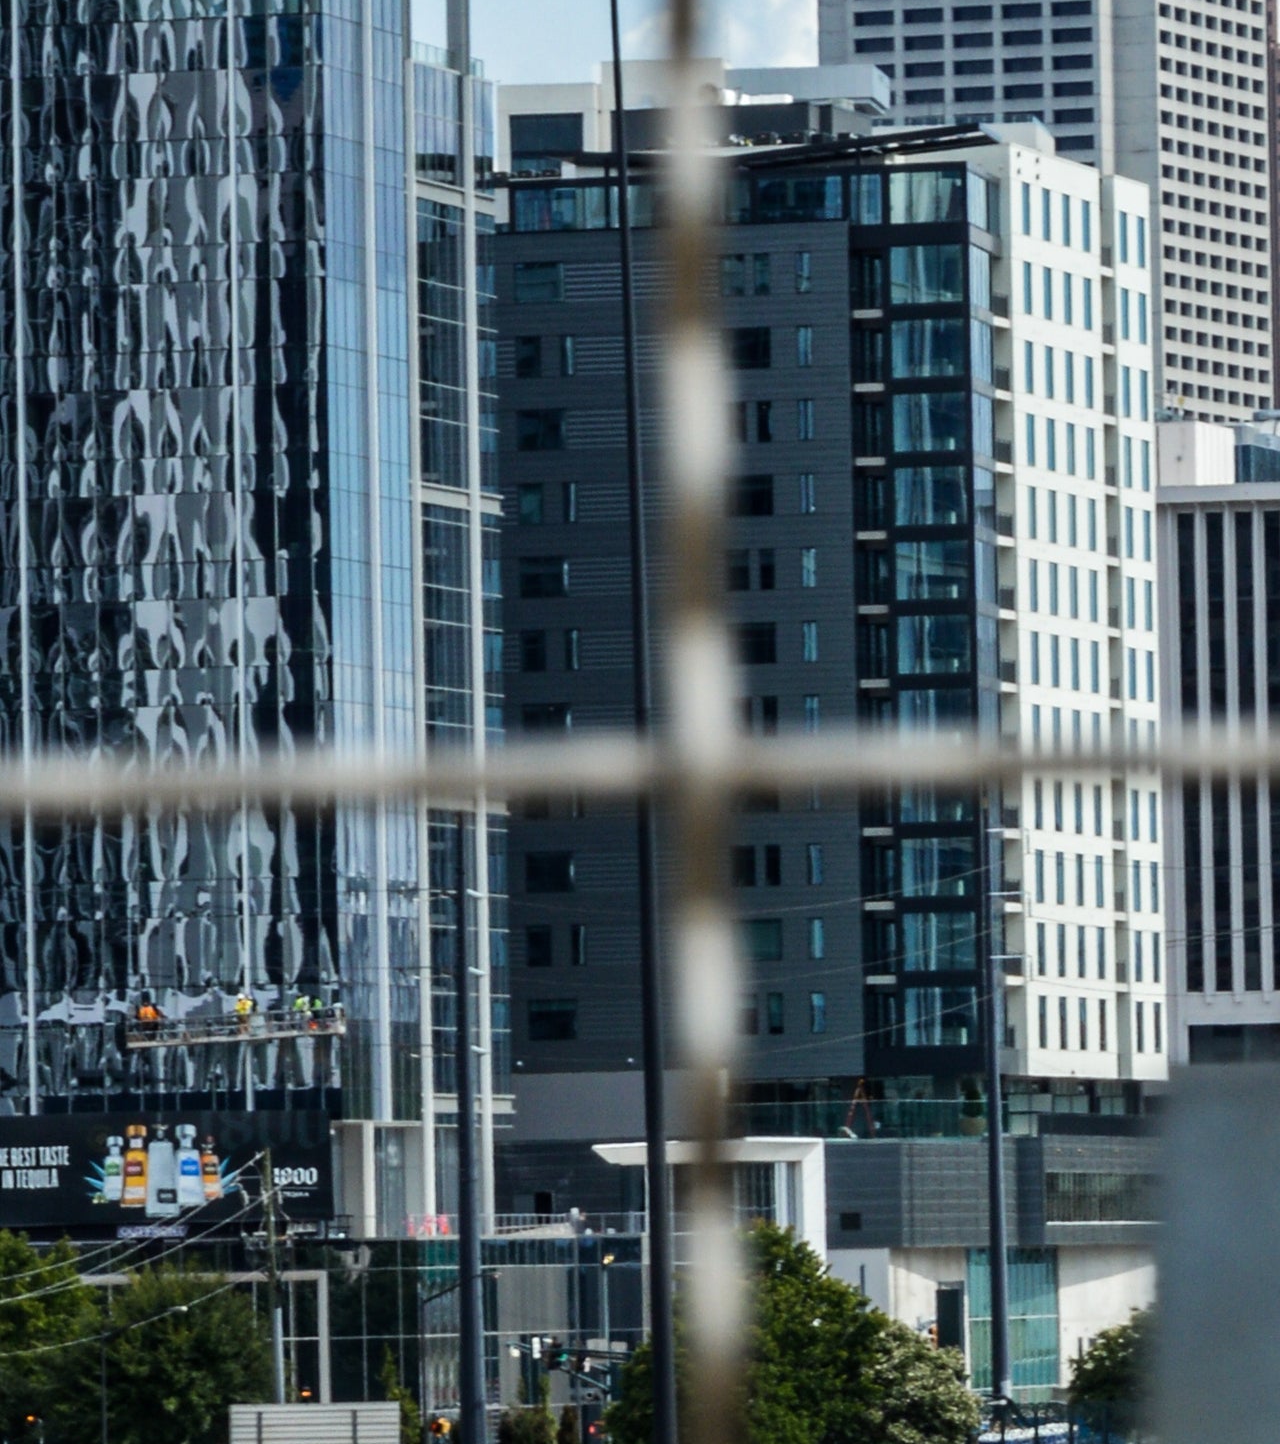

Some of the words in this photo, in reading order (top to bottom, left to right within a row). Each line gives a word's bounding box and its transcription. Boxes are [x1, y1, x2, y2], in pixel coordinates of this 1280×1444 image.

[39, 1146, 70, 1166] TASTE
[16, 1169, 59, 1188] TEQUILA
[273, 1167, 317, 1186] 1800
